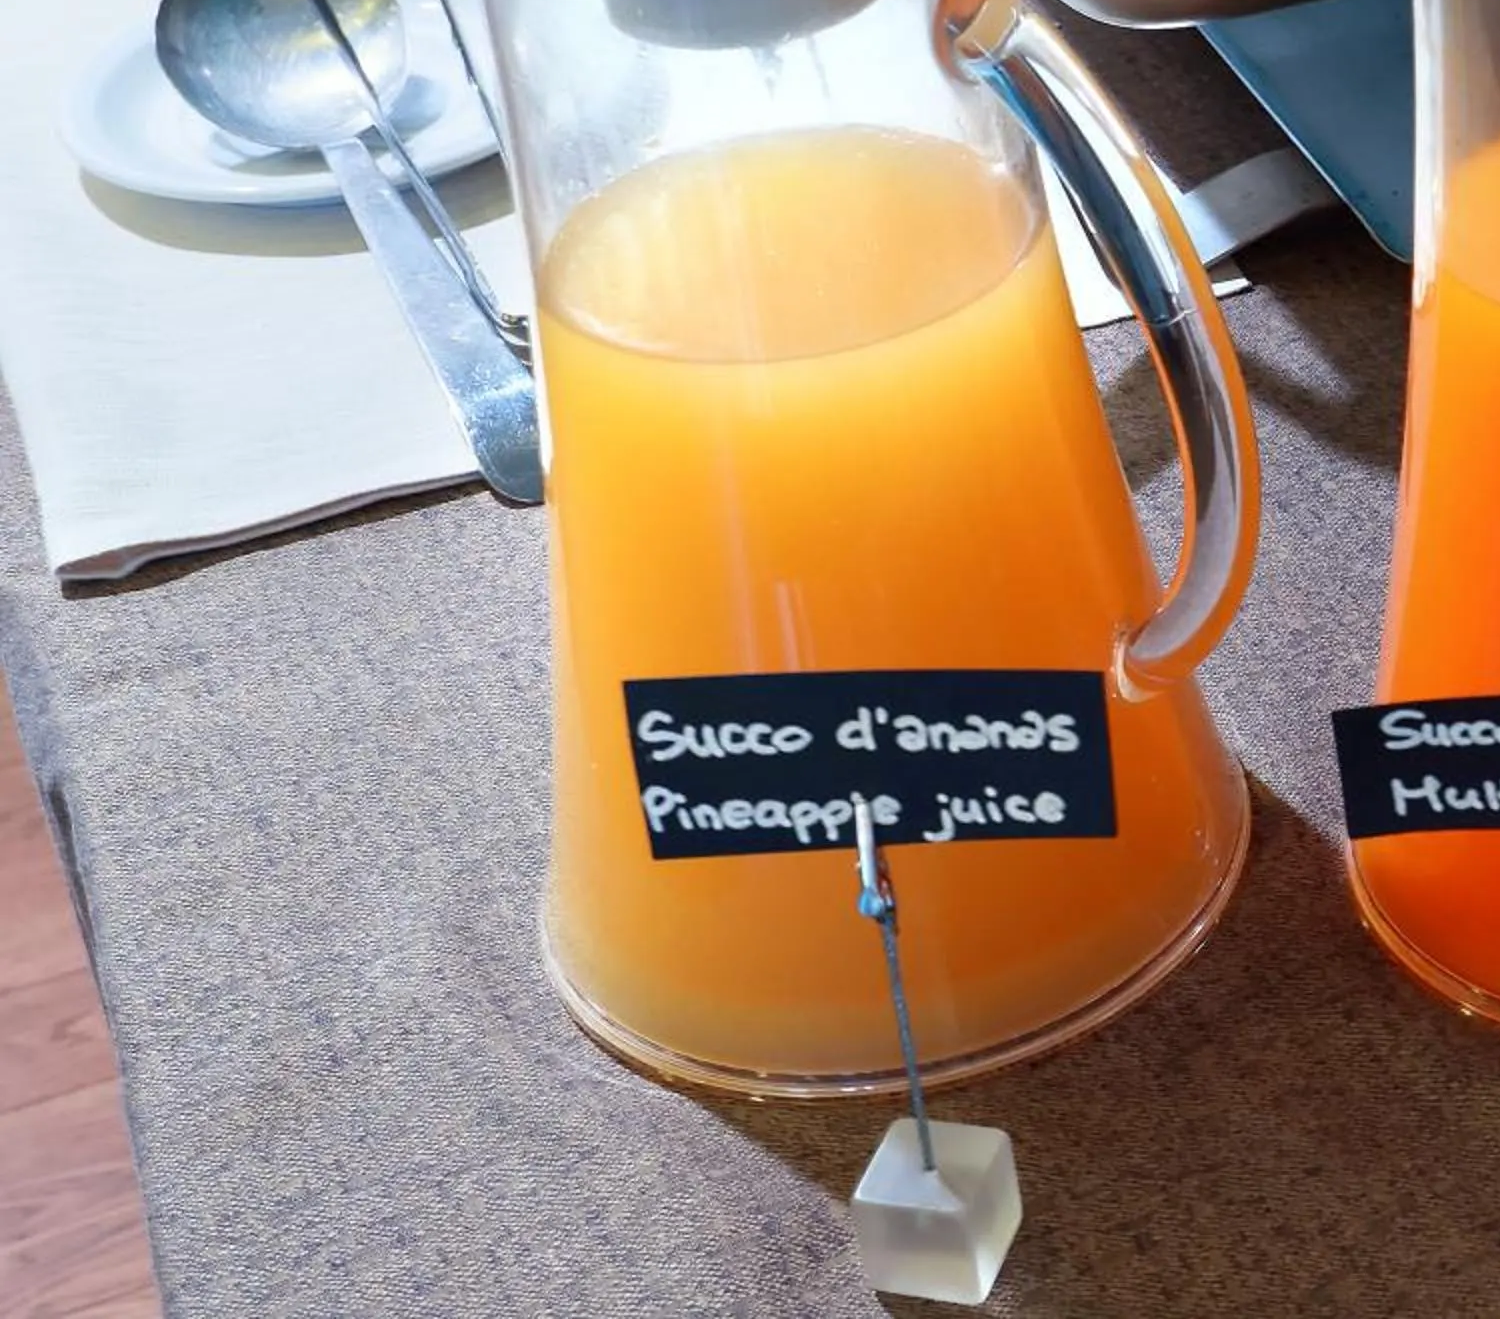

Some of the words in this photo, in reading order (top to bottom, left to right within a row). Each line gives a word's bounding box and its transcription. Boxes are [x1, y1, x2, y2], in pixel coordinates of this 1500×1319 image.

[637, 710, 813, 762] Succo
[835, 706, 1081, 753] d'ananas
[922, 786, 1067, 843] juice
